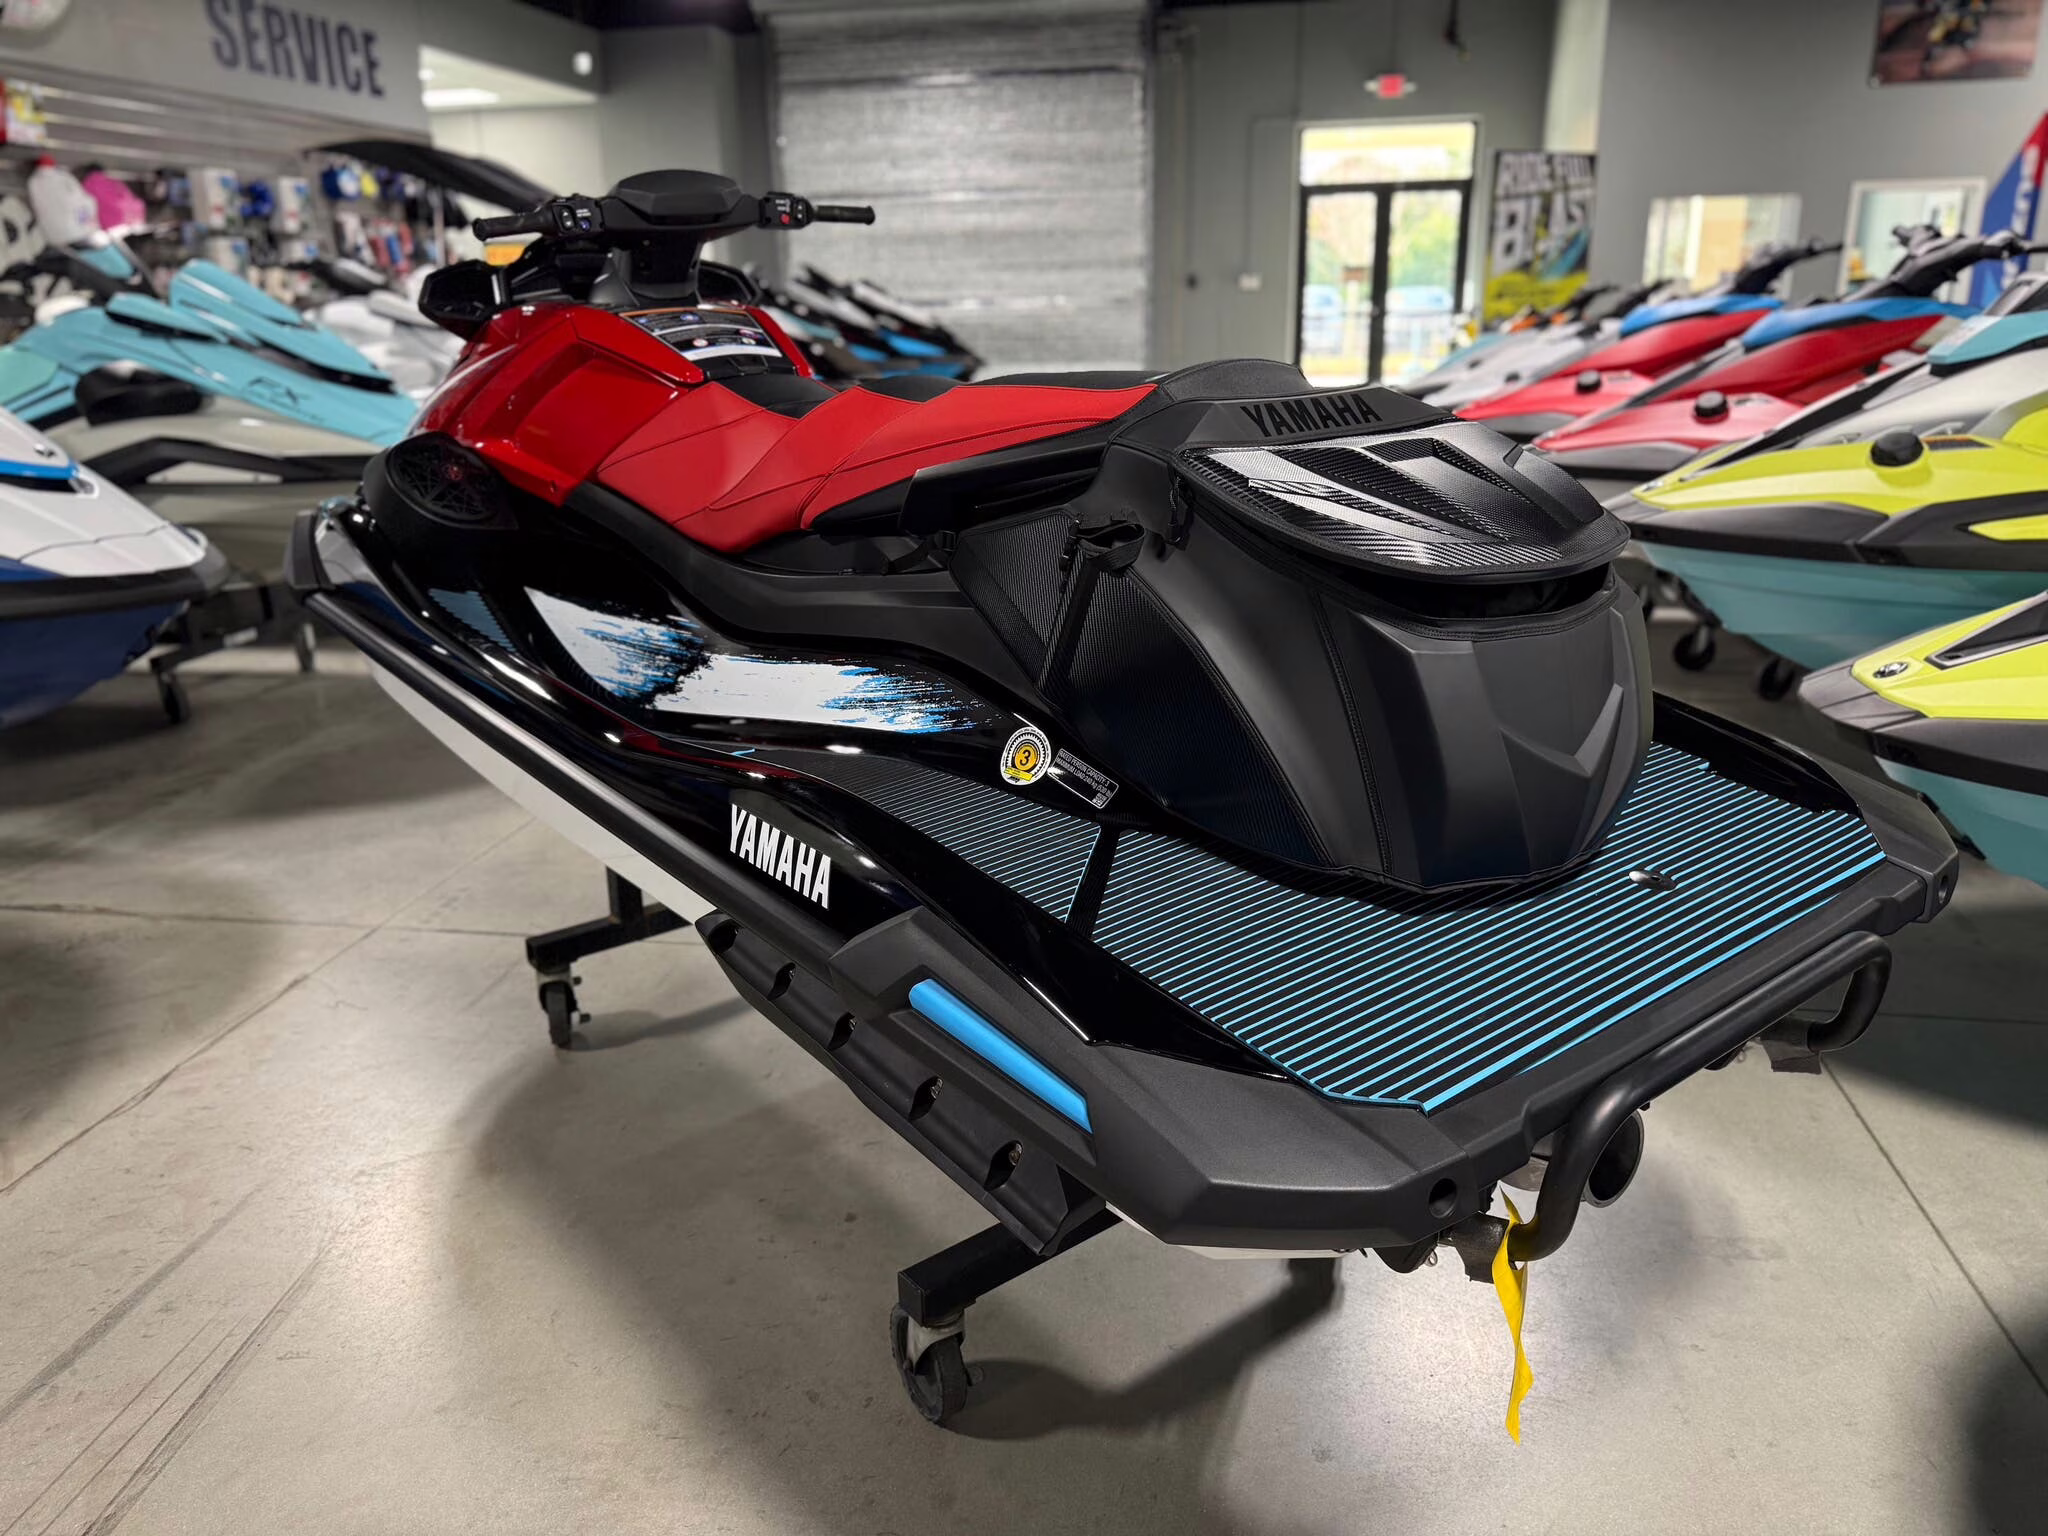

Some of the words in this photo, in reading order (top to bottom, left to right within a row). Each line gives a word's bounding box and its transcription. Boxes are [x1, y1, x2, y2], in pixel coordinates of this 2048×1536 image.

[204, 0, 383, 96] SERVICE
[1240, 393, 1383, 438] YAMAHA
[1020, 749, 1031, 767] 3
[1070, 758, 1088, 773] PERSON
[730, 803, 831, 909] YAMAHA
